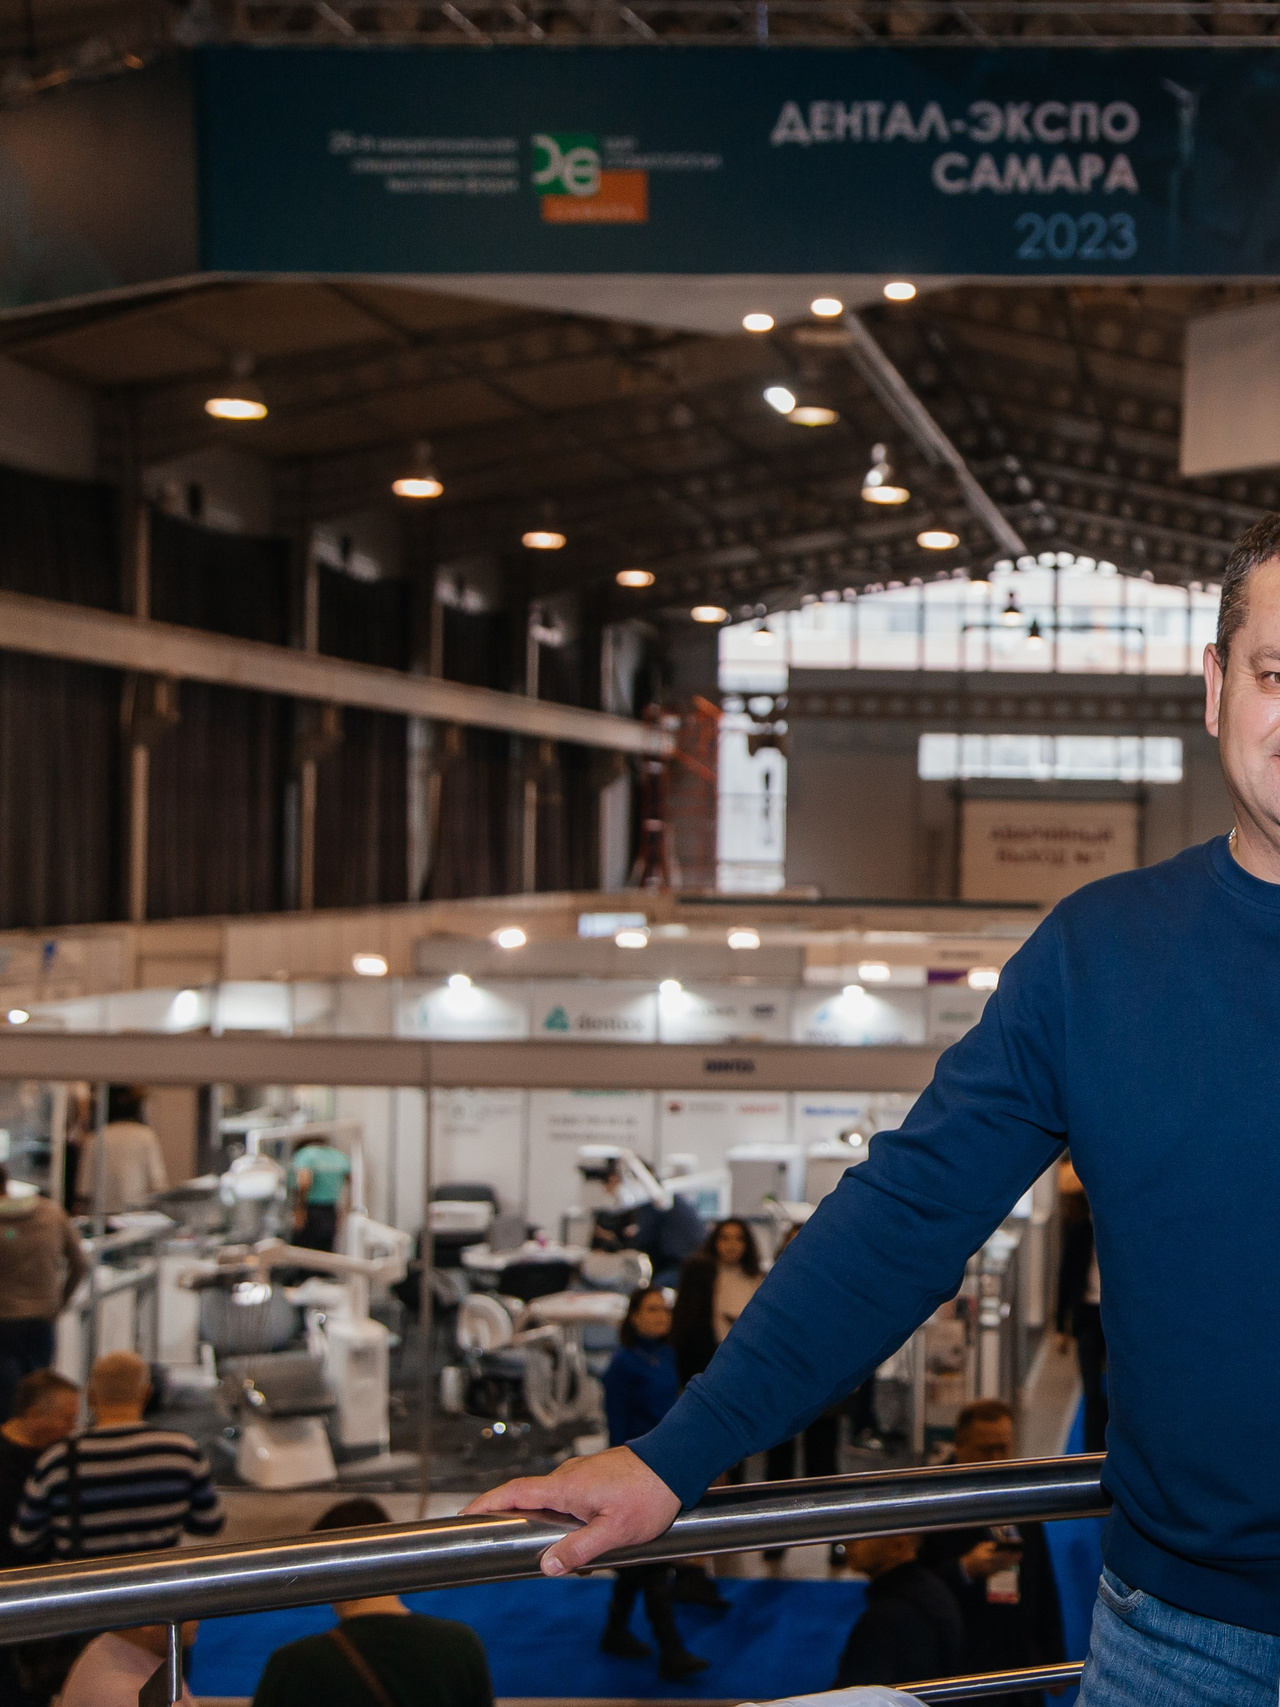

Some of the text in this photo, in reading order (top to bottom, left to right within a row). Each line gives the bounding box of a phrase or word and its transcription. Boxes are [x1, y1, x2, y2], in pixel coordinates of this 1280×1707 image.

[771, 101, 1140, 146] ДЕНТАЛ-ЭКСПО
[932, 152, 1139, 194] САМАРА
[1014, 212, 1138, 259] 2023
